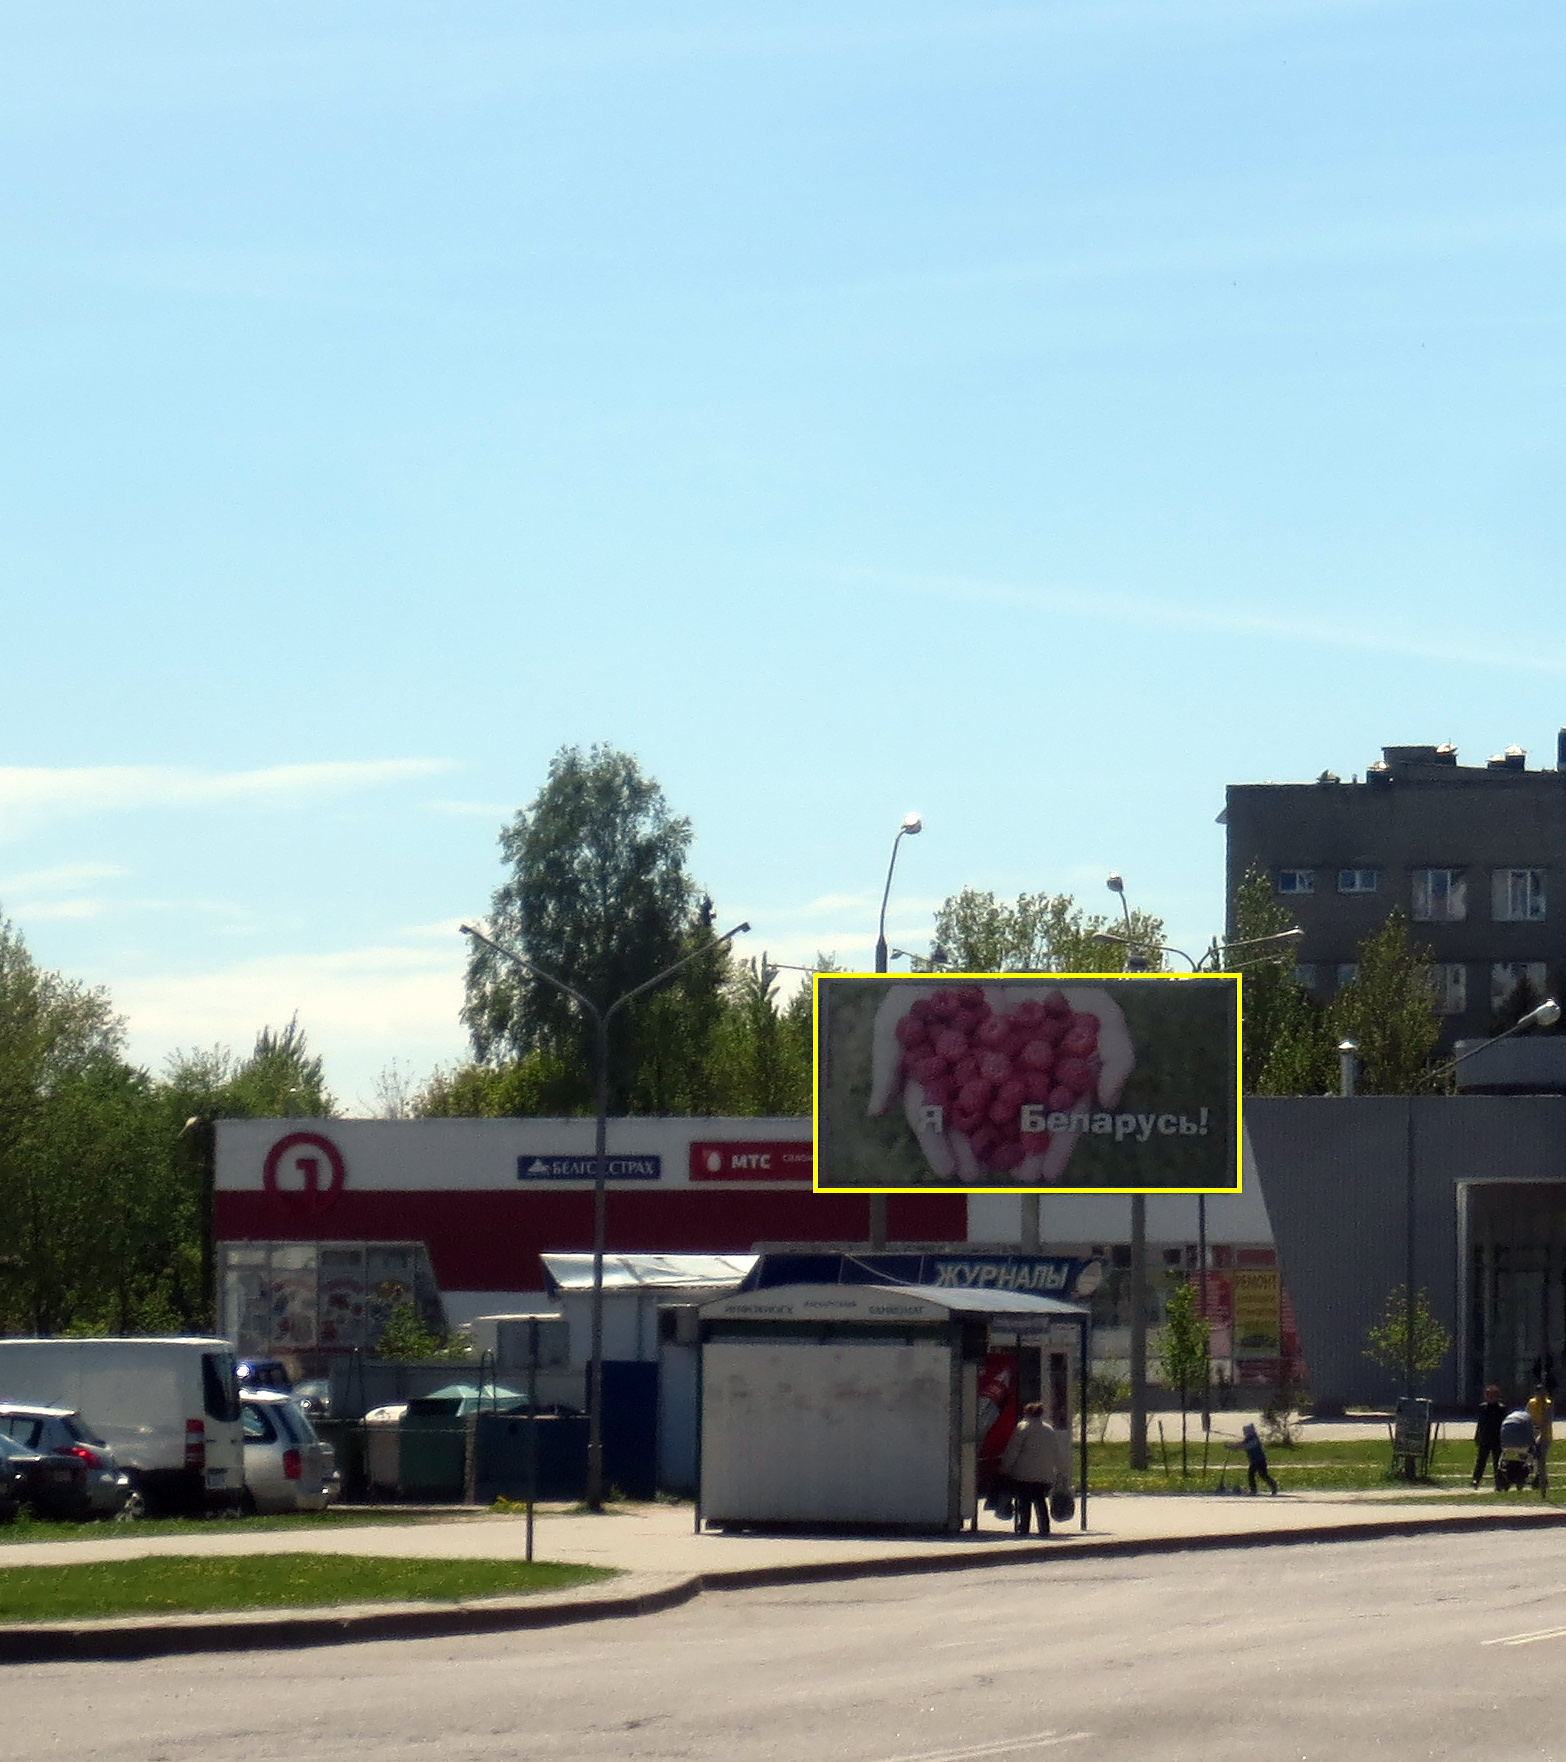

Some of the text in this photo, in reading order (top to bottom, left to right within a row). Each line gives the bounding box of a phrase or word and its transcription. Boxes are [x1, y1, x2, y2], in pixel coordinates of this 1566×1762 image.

[918, 1104, 1209, 1142] Я Беларусь!
[552, 1160, 654, 1176] БЕЛГОСТРАХ
[730, 1153, 772, 1170] МТС
[935, 1262, 1070, 1290] ЖУРНАЛЫ
